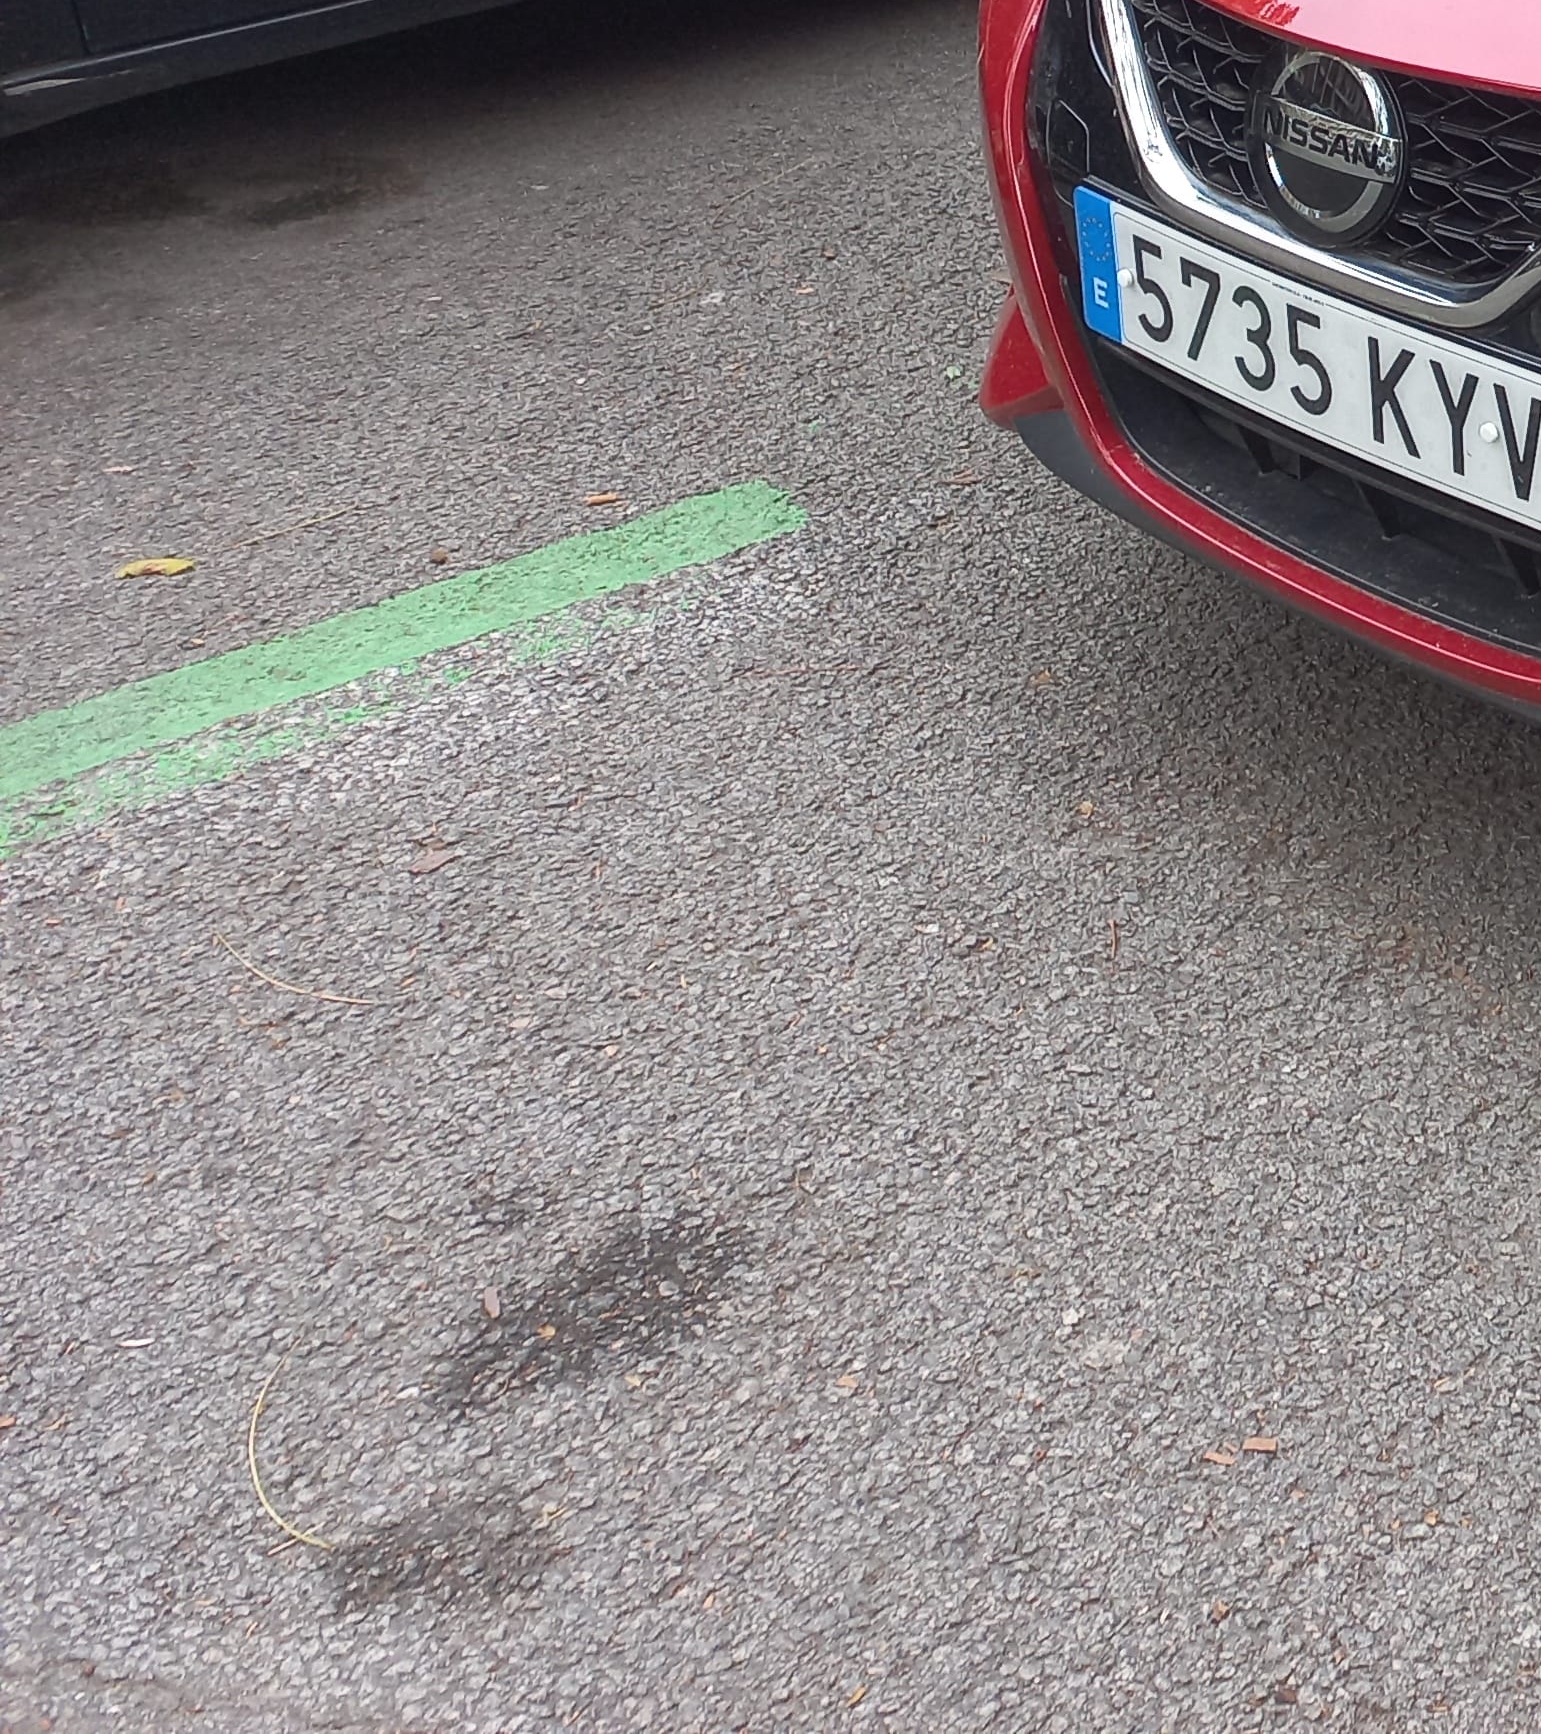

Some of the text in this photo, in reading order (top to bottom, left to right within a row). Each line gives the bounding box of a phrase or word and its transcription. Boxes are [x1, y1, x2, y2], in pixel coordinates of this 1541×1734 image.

[1262, 100, 1379, 169] NISSAN
[1093, 276, 1109, 308] E
[1132, 233, 1333, 416] 5735
